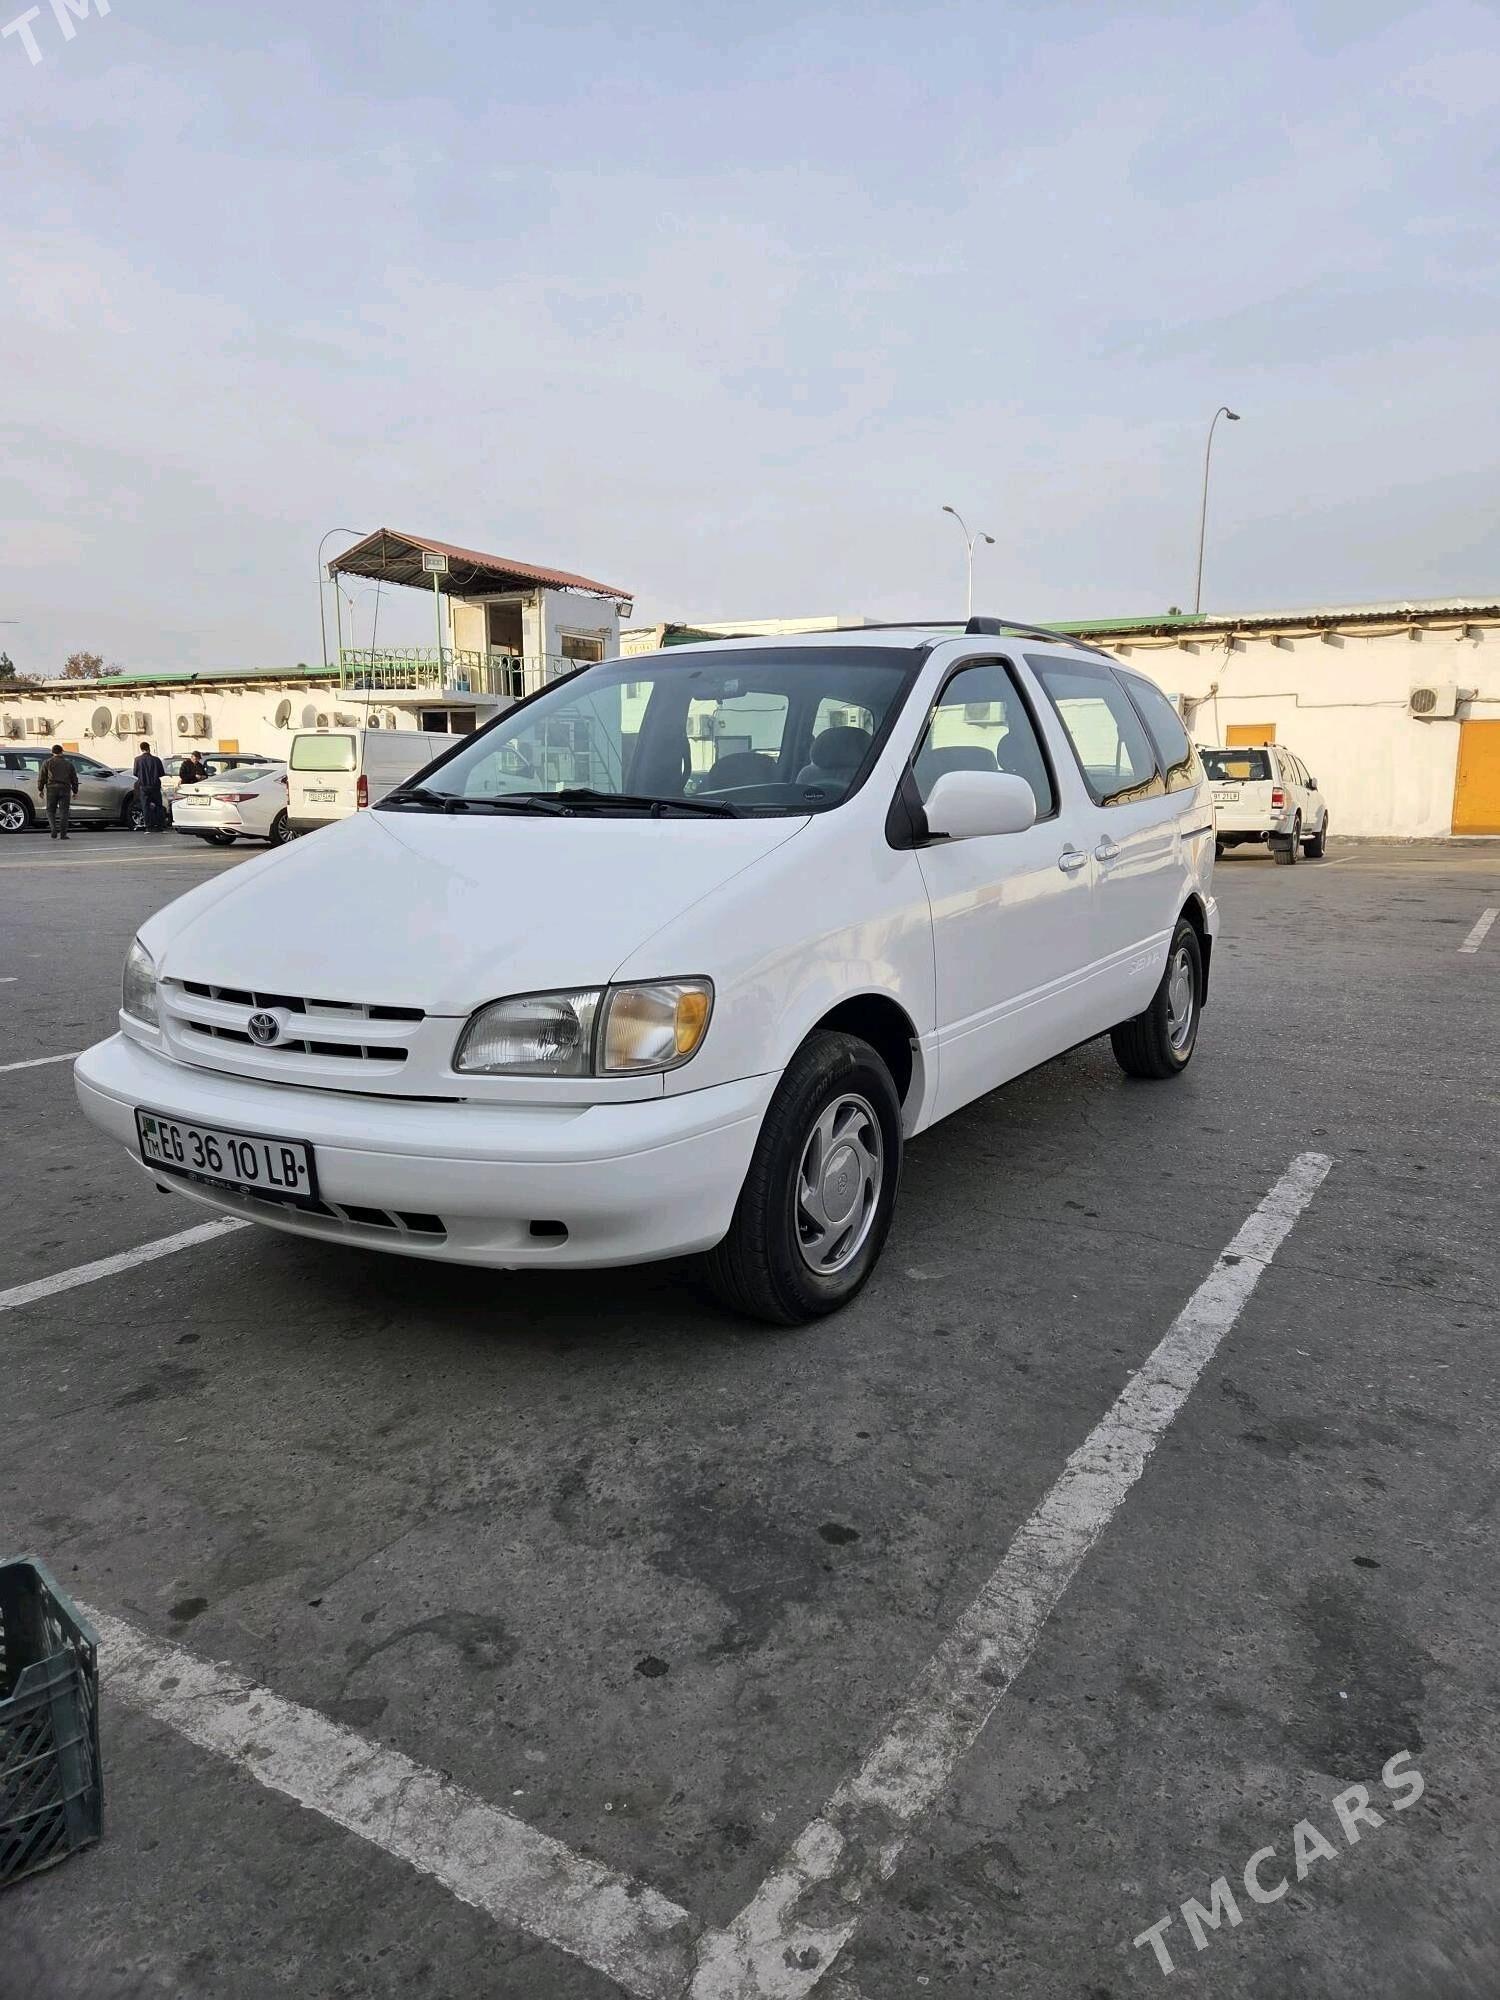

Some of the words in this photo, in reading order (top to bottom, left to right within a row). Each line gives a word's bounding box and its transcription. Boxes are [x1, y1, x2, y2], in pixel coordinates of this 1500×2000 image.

[145, 1137, 161, 1157] TM
[157, 1121, 185, 1162] EG
[188, 1130, 223, 1173] 36
[227, 1139, 259, 1180] 10
[264, 1145, 298, 1187] LB
